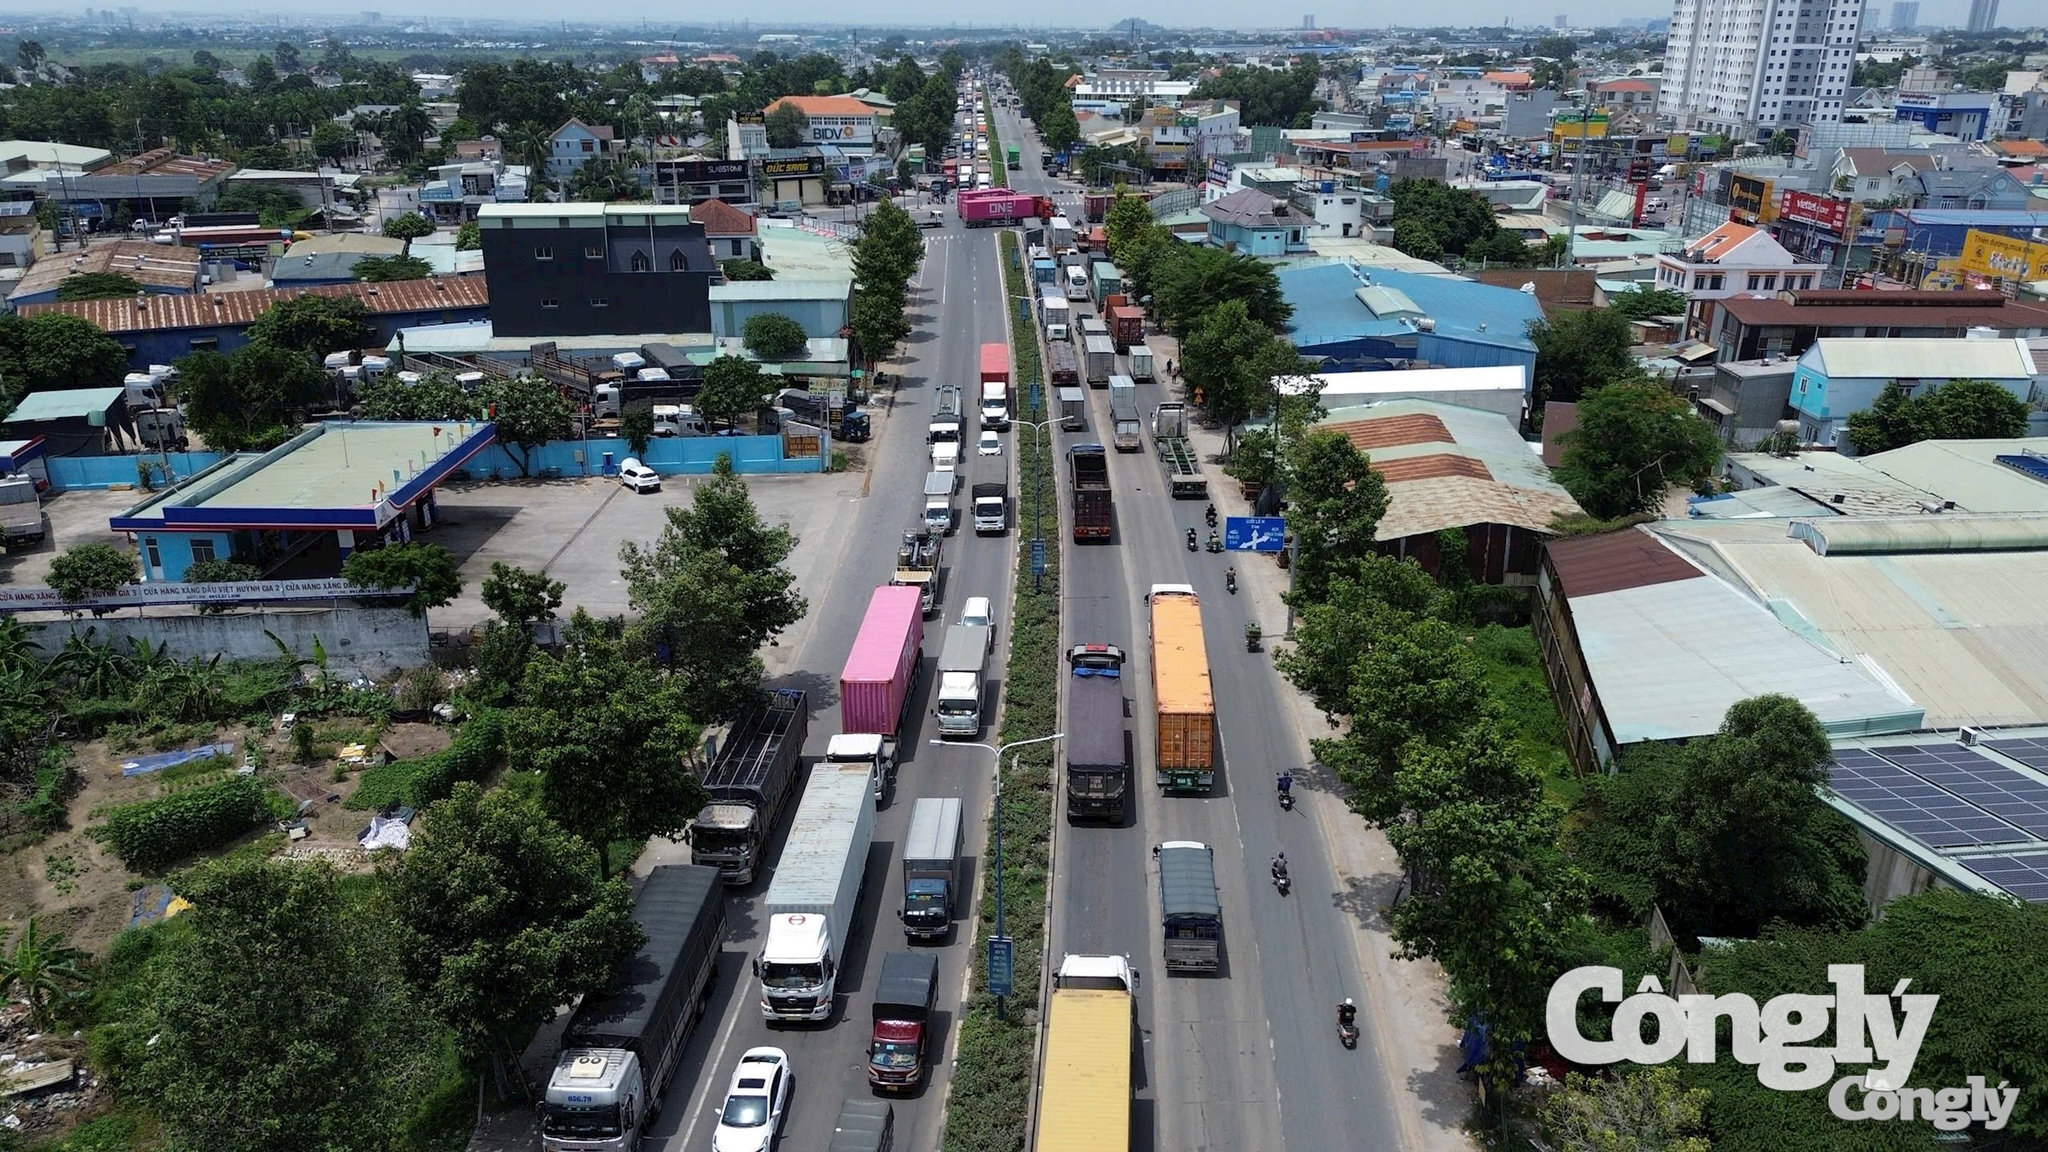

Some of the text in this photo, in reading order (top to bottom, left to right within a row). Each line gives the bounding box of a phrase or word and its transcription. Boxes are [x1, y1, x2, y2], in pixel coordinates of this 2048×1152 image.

[813, 128, 843, 139] BIDV
[786, 161, 809, 172] SANG
[989, 202, 1013, 213] ONE
[119, 589, 131, 597] GIA
[132, 589, 137, 597] 3
[160, 586, 180, 595] HÀNG
[181, 585, 200, 594] XĂNG
[218, 585, 234, 594] VIỆT
